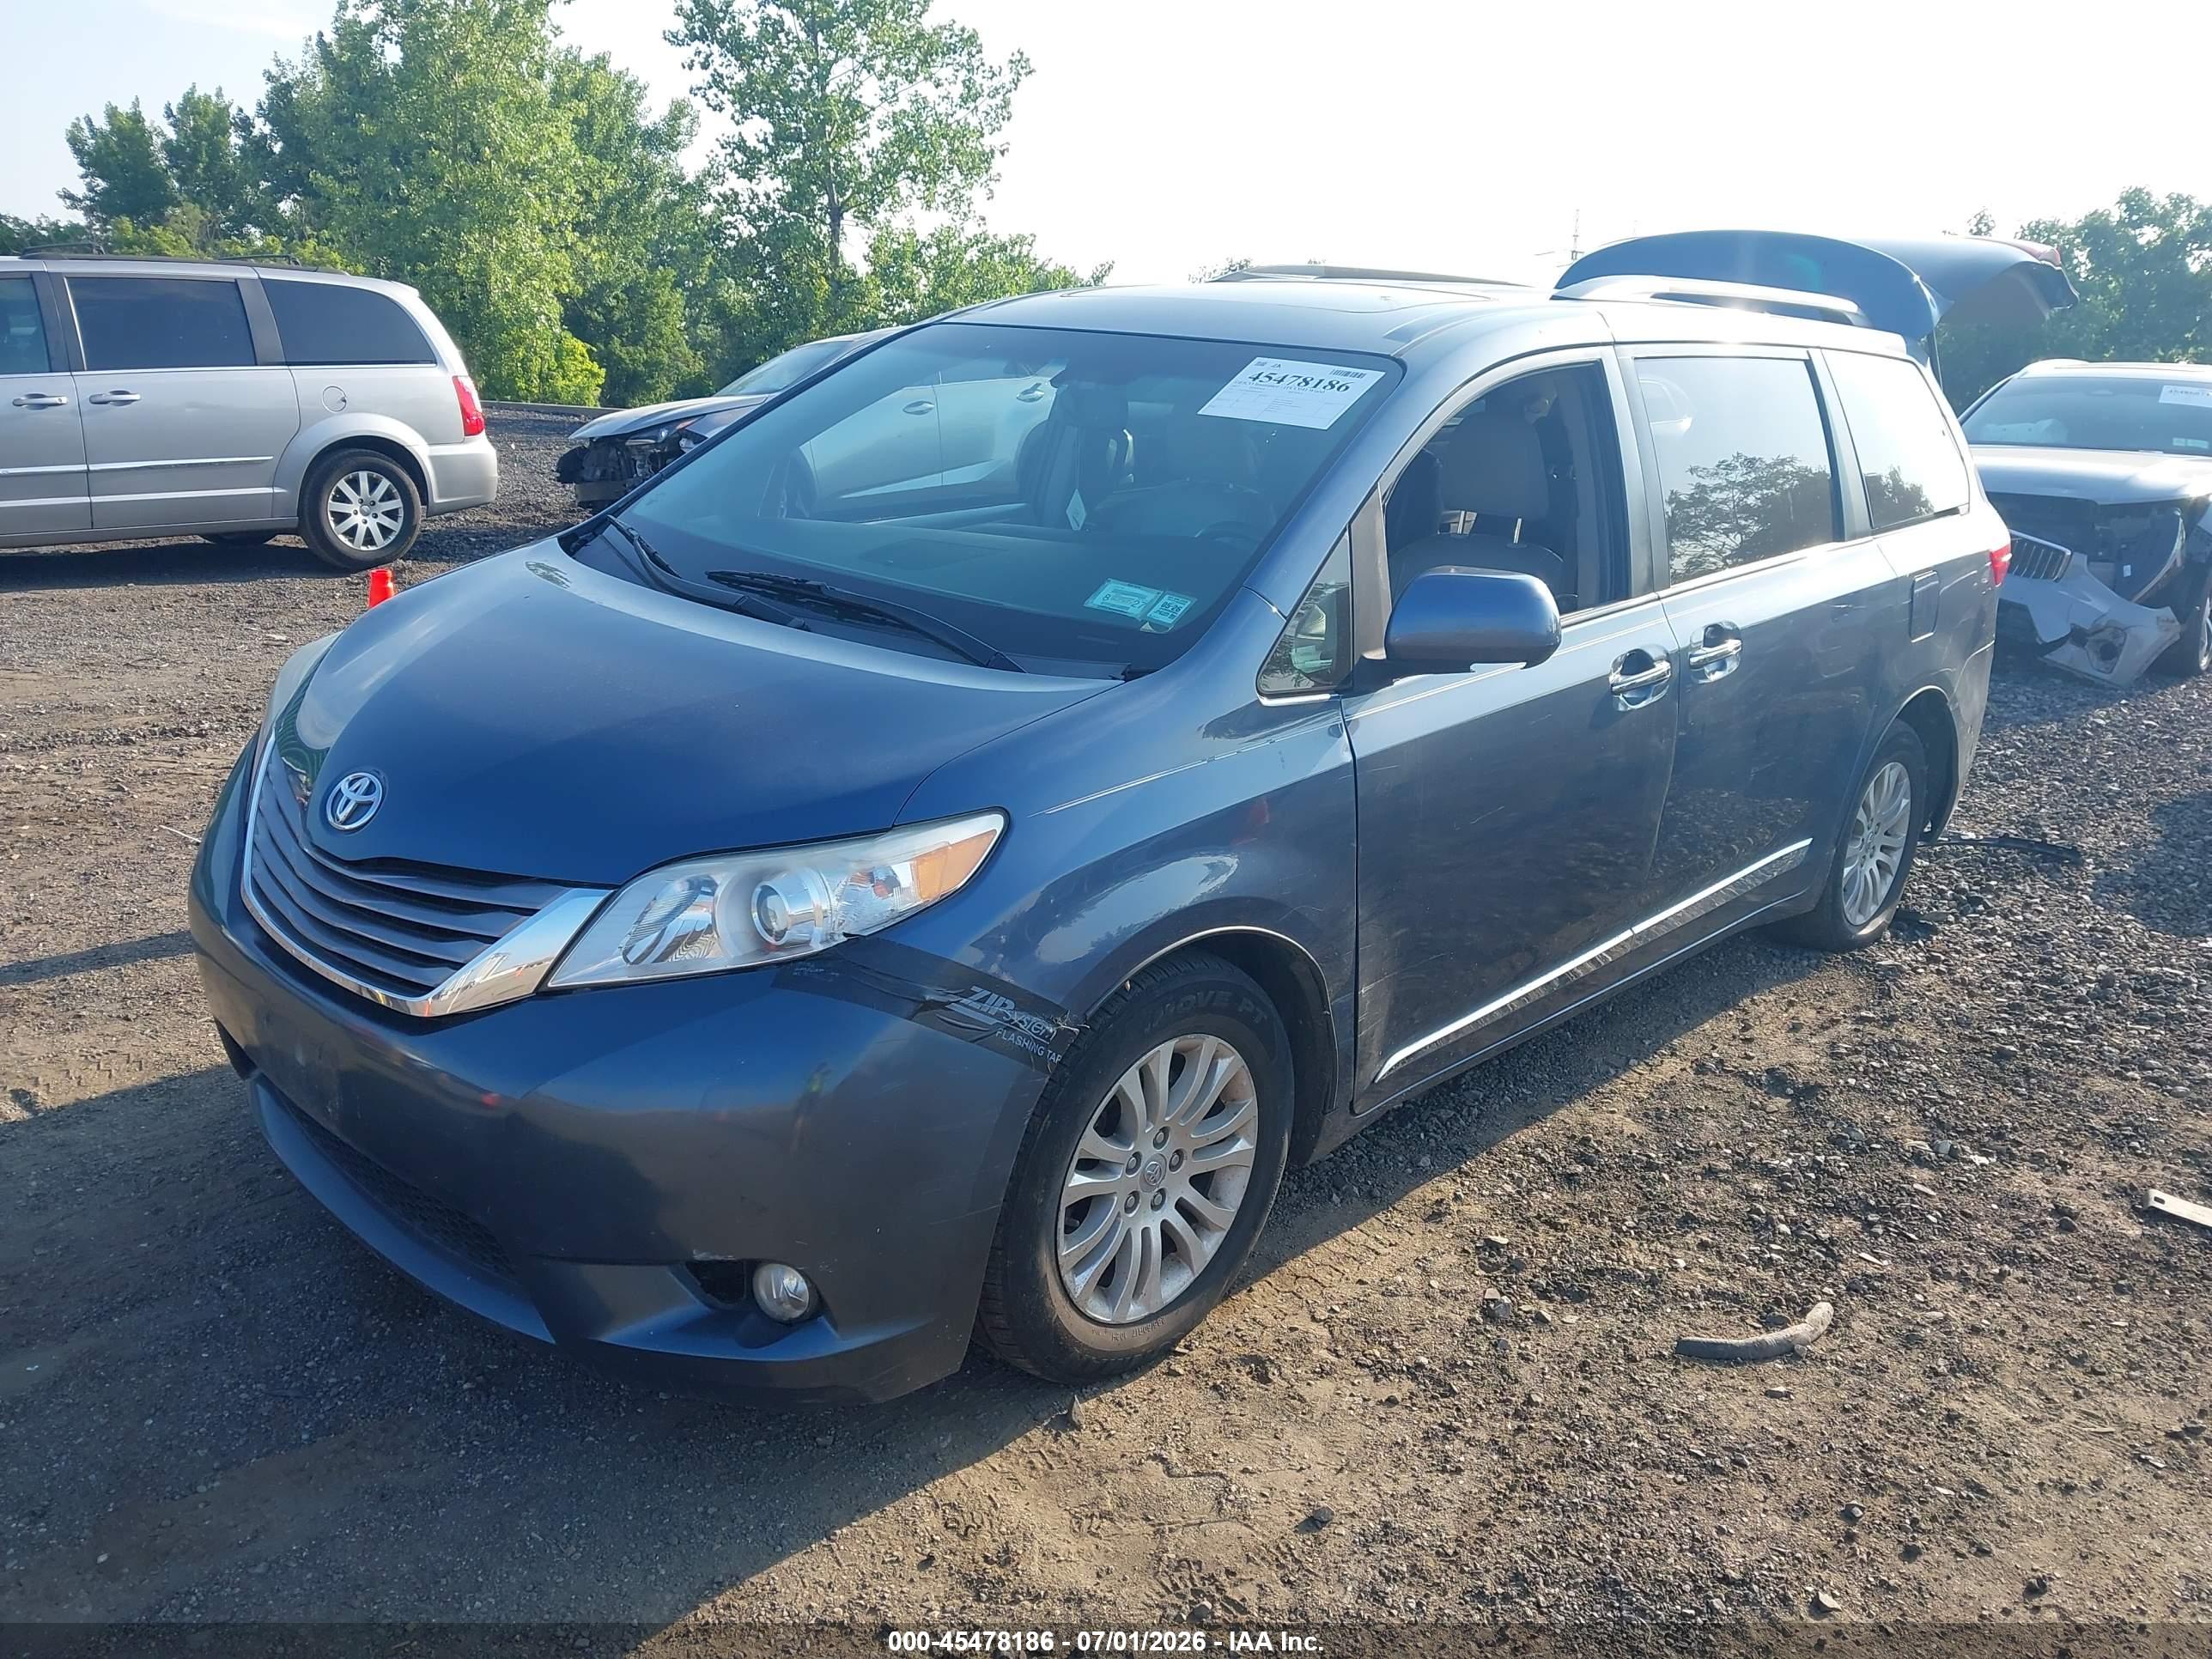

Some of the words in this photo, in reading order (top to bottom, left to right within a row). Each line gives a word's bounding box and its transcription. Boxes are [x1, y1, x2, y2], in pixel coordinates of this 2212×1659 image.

[1248, 370, 1354, 393] 45478186
[959, 985, 1017, 1016] ZIP
[995, 1027, 1046, 1057] FLASHING
